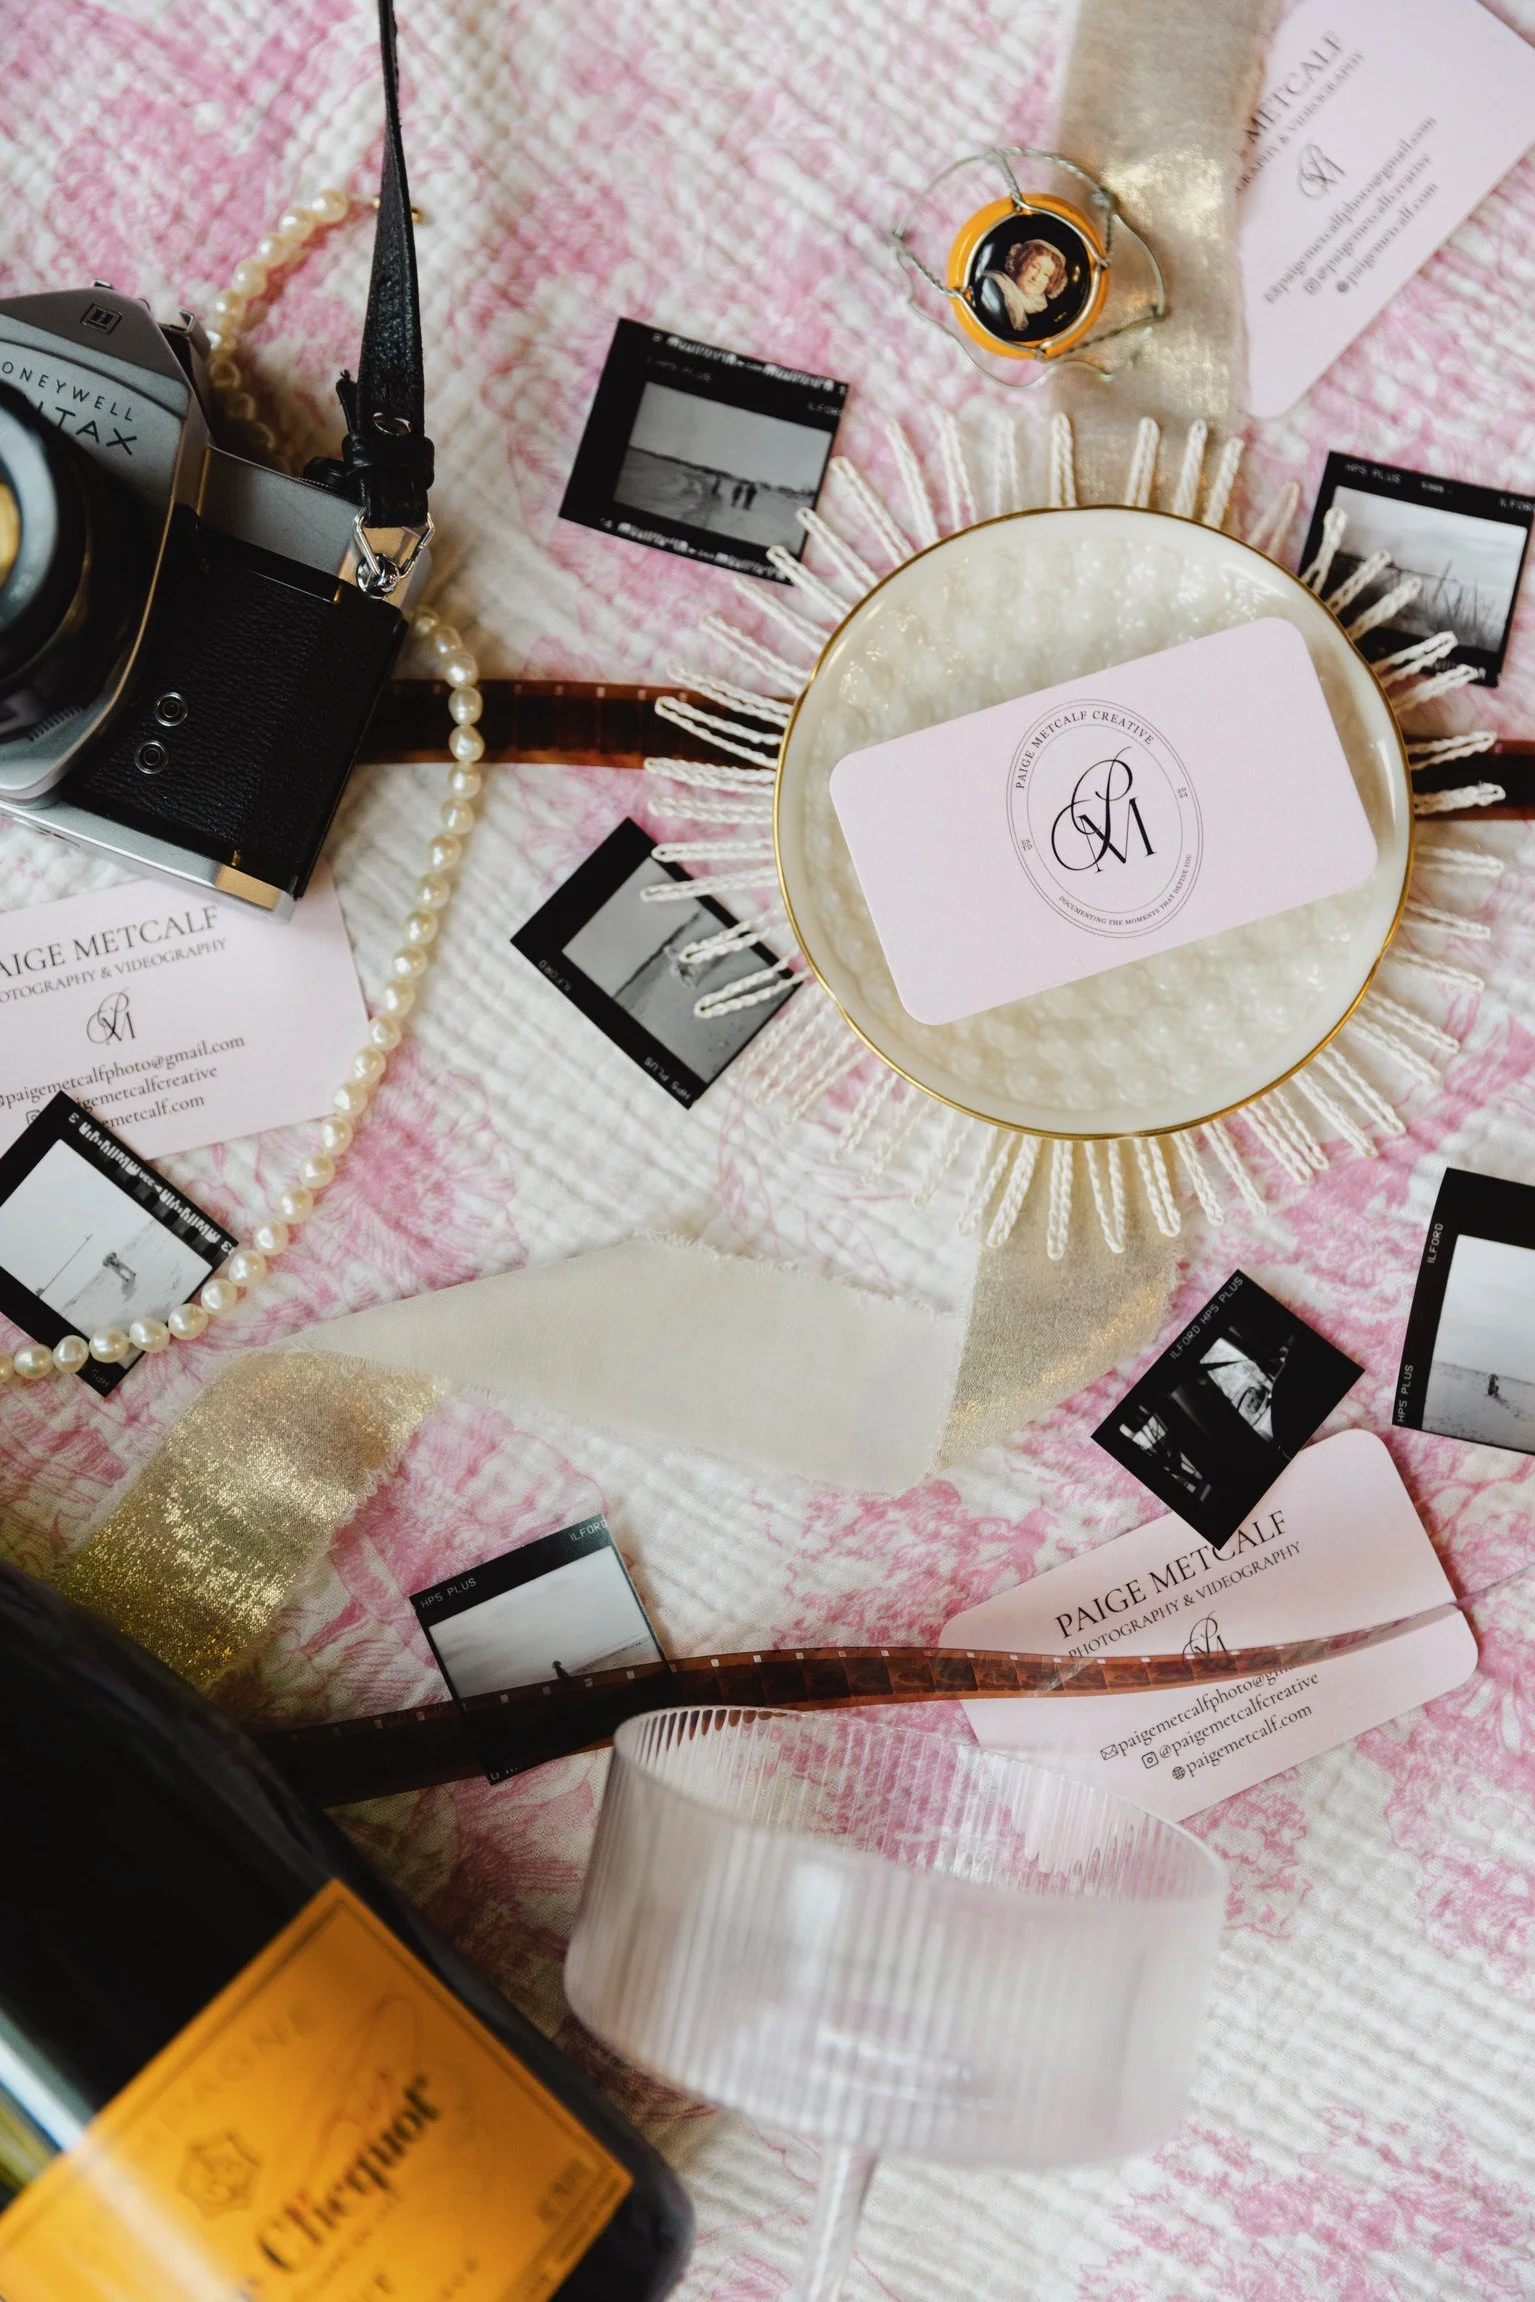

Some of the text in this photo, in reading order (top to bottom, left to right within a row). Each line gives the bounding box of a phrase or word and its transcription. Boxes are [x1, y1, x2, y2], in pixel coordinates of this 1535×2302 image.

[1244, 30, 1343, 145] METCALF
[1290, 49, 1365, 132] VIDEOGRAPHY
[1, 361, 134, 422] ONEYWELL
[1015, 710, 1154, 790] PAIGE METCALF CREATIVE
[1058, 853, 1192, 926] DOCUMENTING THE MOMENTS THAT DEFINE YOU
[0, 937, 227, 1002] OTOGRAPHY & VIDEOGRAPHY
[73, 904, 219, 962] METCALF
[1427, 1222, 1444, 1264] ILFORD
[1169, 1324, 1201, 1360] ILFORD
[1218, 1276, 1244, 1304] PLUS
[1401, 1363, 1414, 1396] PLUS
[446, 1577, 477, 1597] PLUS
[1055, 1510, 1289, 1640] PAIGE METCALF
[1068, 1540, 1301, 1658] PHOTOGRAPHY & VIDEOGRAPHY
[1159, 1671, 1320, 1759] @paigemetcalfcreative
[1186, 1704, 1313, 1777] paigemetcalf.com
